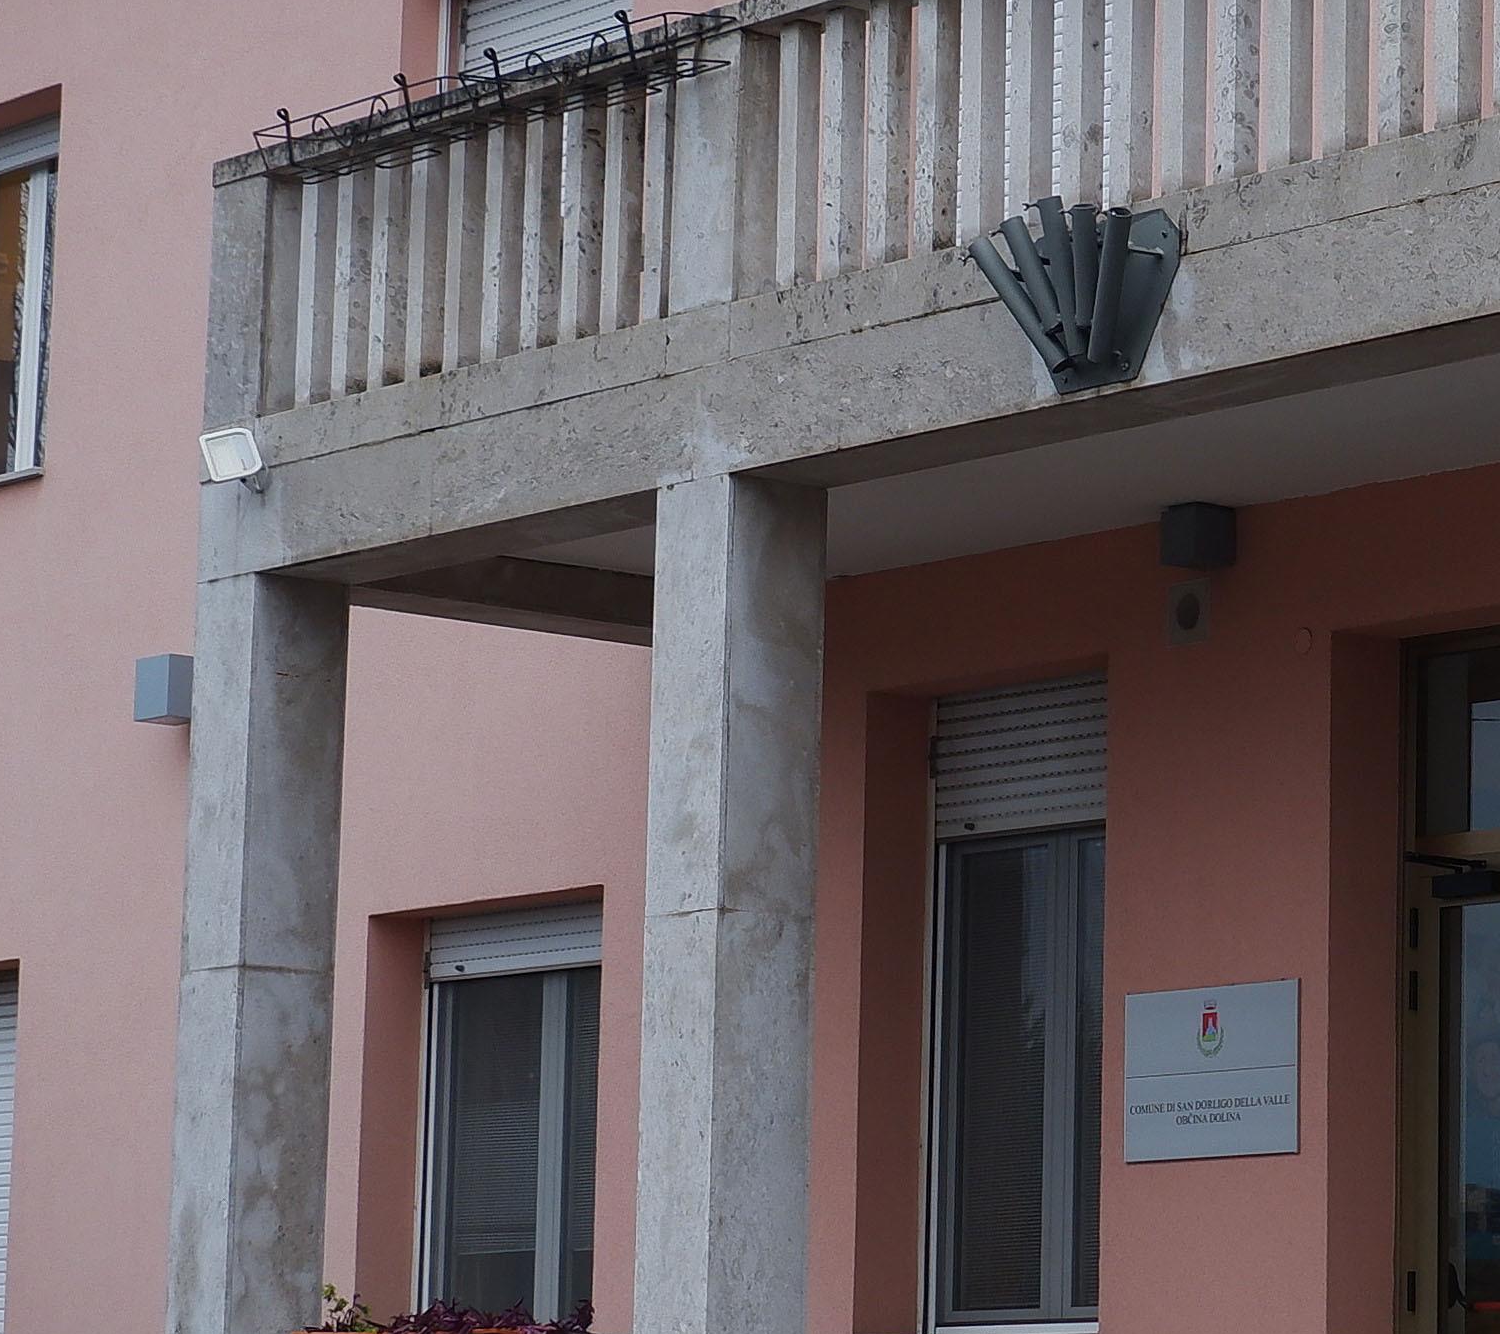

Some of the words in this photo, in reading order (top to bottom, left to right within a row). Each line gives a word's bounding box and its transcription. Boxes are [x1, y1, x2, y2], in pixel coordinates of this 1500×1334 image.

[1129, 1103, 1166, 1115] COMUNE
[1166, 1101, 1176, 1112] DI
[1177, 1099, 1194, 1111] SAN
[1195, 1098, 1233, 1110] DORLIGO
[1234, 1095, 1262, 1108] DELLA
[1264, 1093, 1291, 1106] VALLE
[1175, 1112, 1208, 1126] OBČINA
[1209, 1113, 1241, 1124] DOLINA
